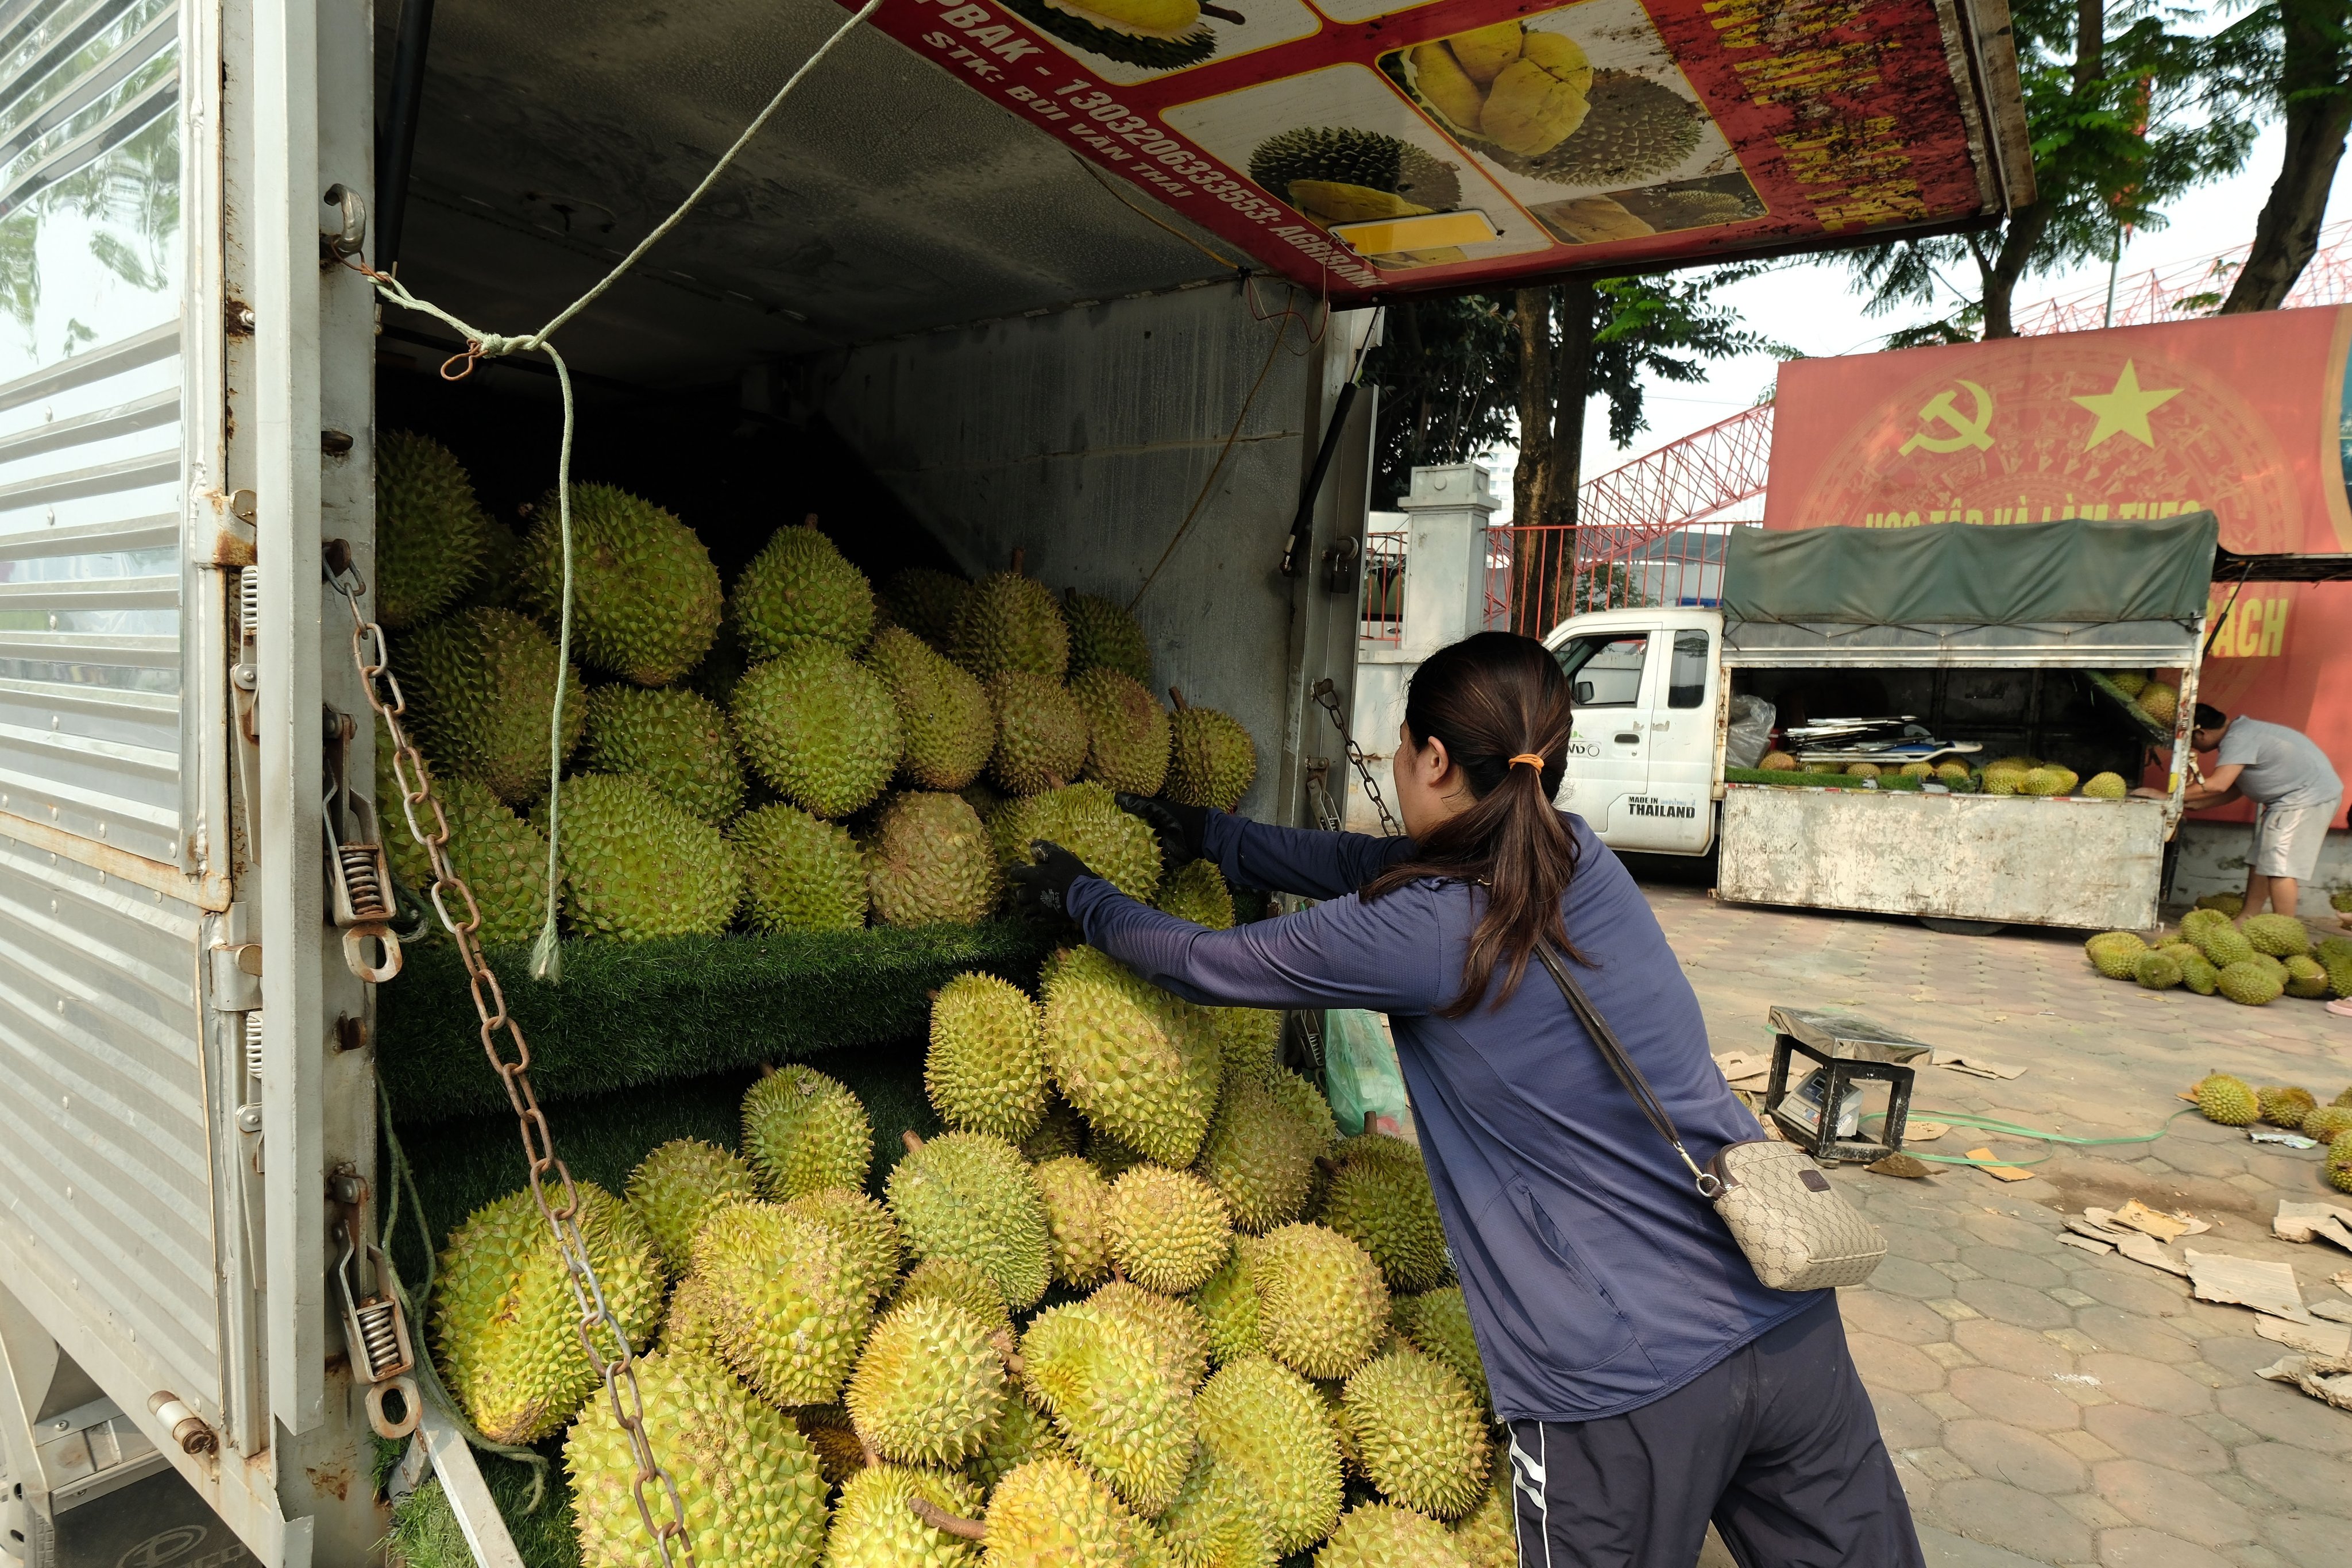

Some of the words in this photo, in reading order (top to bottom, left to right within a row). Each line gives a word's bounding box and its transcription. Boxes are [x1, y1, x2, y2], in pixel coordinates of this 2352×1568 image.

[922, 32, 1005, 83] STK:
[1068, 123, 1133, 161] VĂN
[1130, 162, 1195, 198] THÁI
[1055, 79, 1281, 224] 1303206333553:
[1268, 226, 1389, 289] AGRIBANK
[1629, 804, 1695, 818] THAILAND
